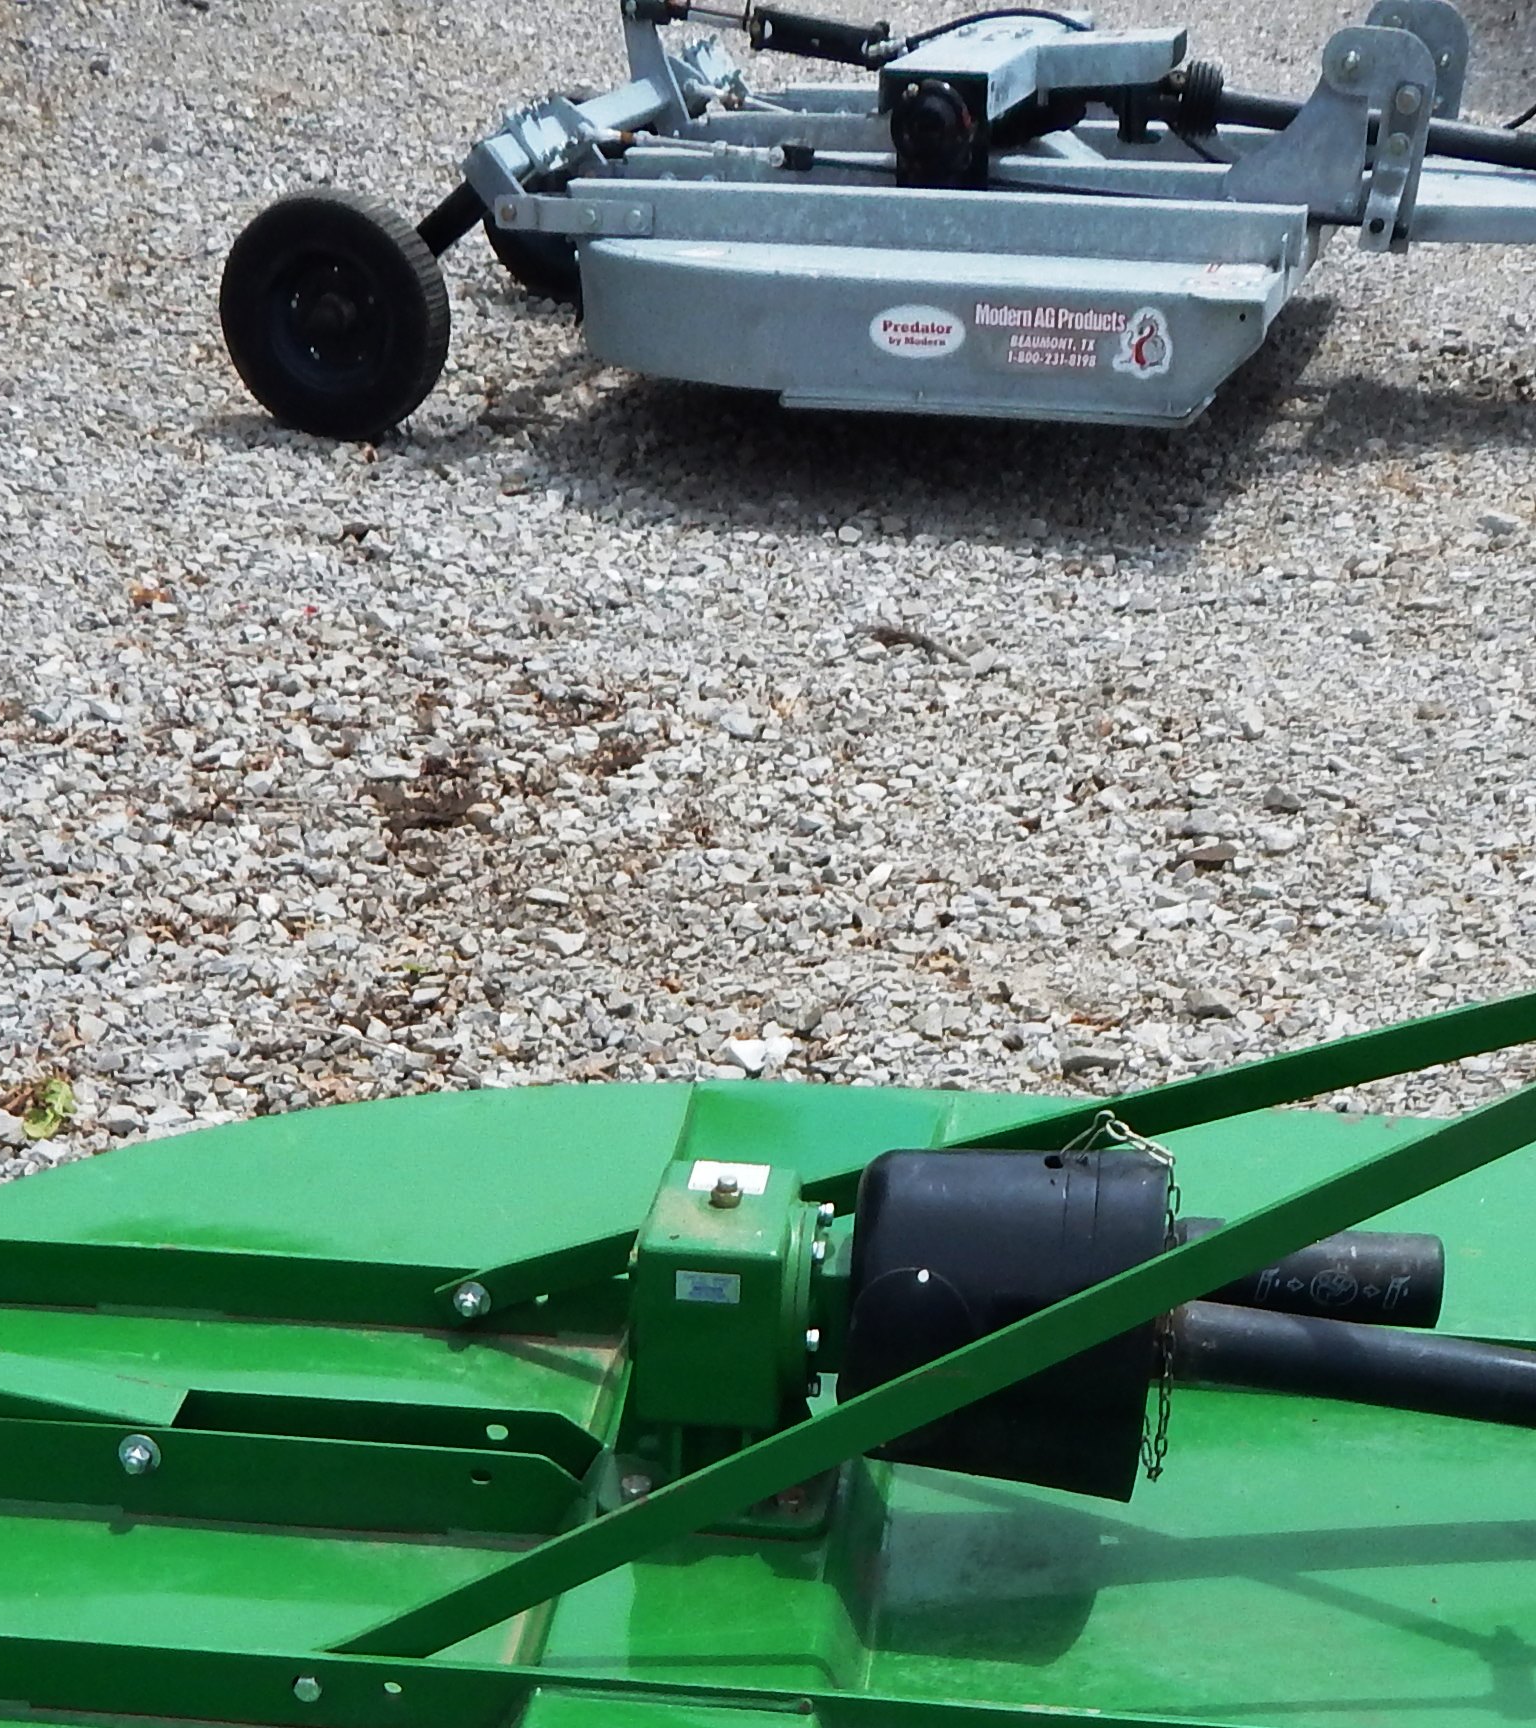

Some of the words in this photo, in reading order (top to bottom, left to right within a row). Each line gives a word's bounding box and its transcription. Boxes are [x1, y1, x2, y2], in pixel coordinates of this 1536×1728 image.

[975, 303, 1032, 327] Modern
[1034, 306, 1055, 329] AG
[1057, 308, 1126, 332] Products
[882, 319, 953, 334] Predator
[1081, 338, 1096, 351] TX
